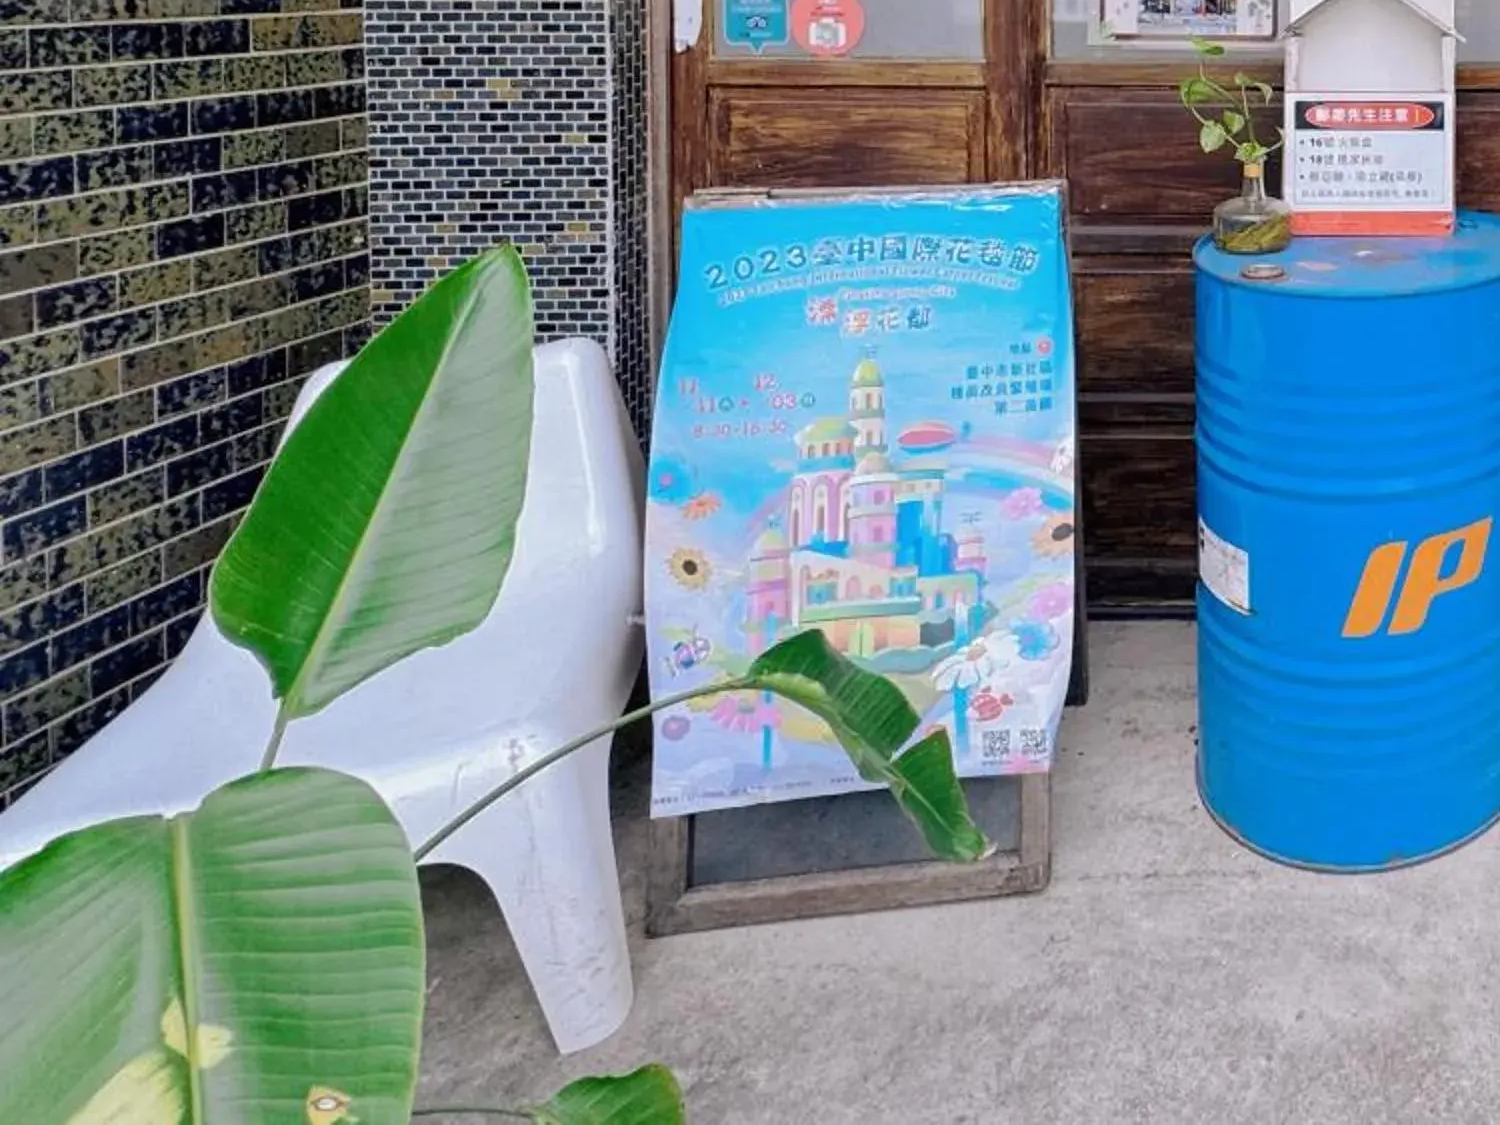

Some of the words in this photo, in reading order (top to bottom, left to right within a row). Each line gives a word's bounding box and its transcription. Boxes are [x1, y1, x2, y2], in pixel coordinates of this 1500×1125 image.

[705, 234, 1039, 290] 2023臺中國際花毯節
